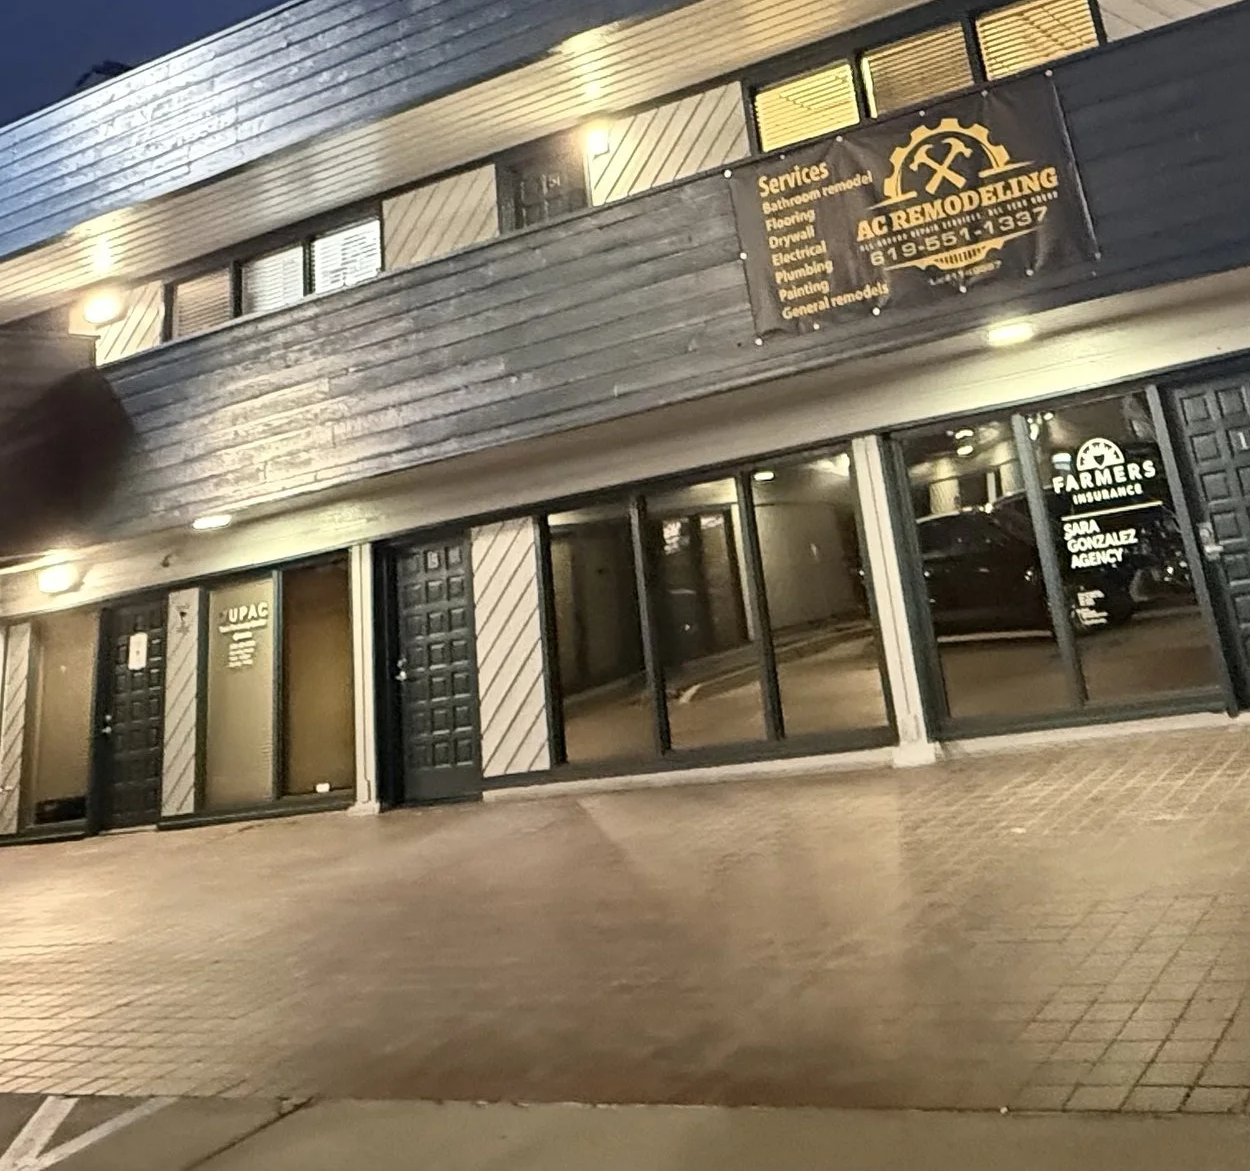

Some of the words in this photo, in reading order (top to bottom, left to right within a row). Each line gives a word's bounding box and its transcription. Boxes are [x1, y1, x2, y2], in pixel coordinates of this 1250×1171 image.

[758, 162, 830, 197] Services
[762, 188, 821, 215] Bathroom
[822, 170, 873, 197] remodel
[856, 216, 889, 242] AC
[889, 166, 1059, 231] REMODELING
[765, 209, 816, 231] Flooring
[768, 225, 815, 248] Drywall
[870, 206, 1048, 266] 619-551-1337
[772, 240, 827, 266] Electrical
[775, 260, 834, 284] Plumbing
[778, 280, 830, 302] Painting
[782, 296, 830, 319] General
[831, 282, 889, 307] remodels
[1052, 460, 1156, 494] FARMERS
[1072, 483, 1144, 505] INSURANCE
[1063, 519, 1100, 540] SARA
[1067, 528, 1139, 553] GONZALEZ
[1071, 548, 1124, 570] AGENCY
